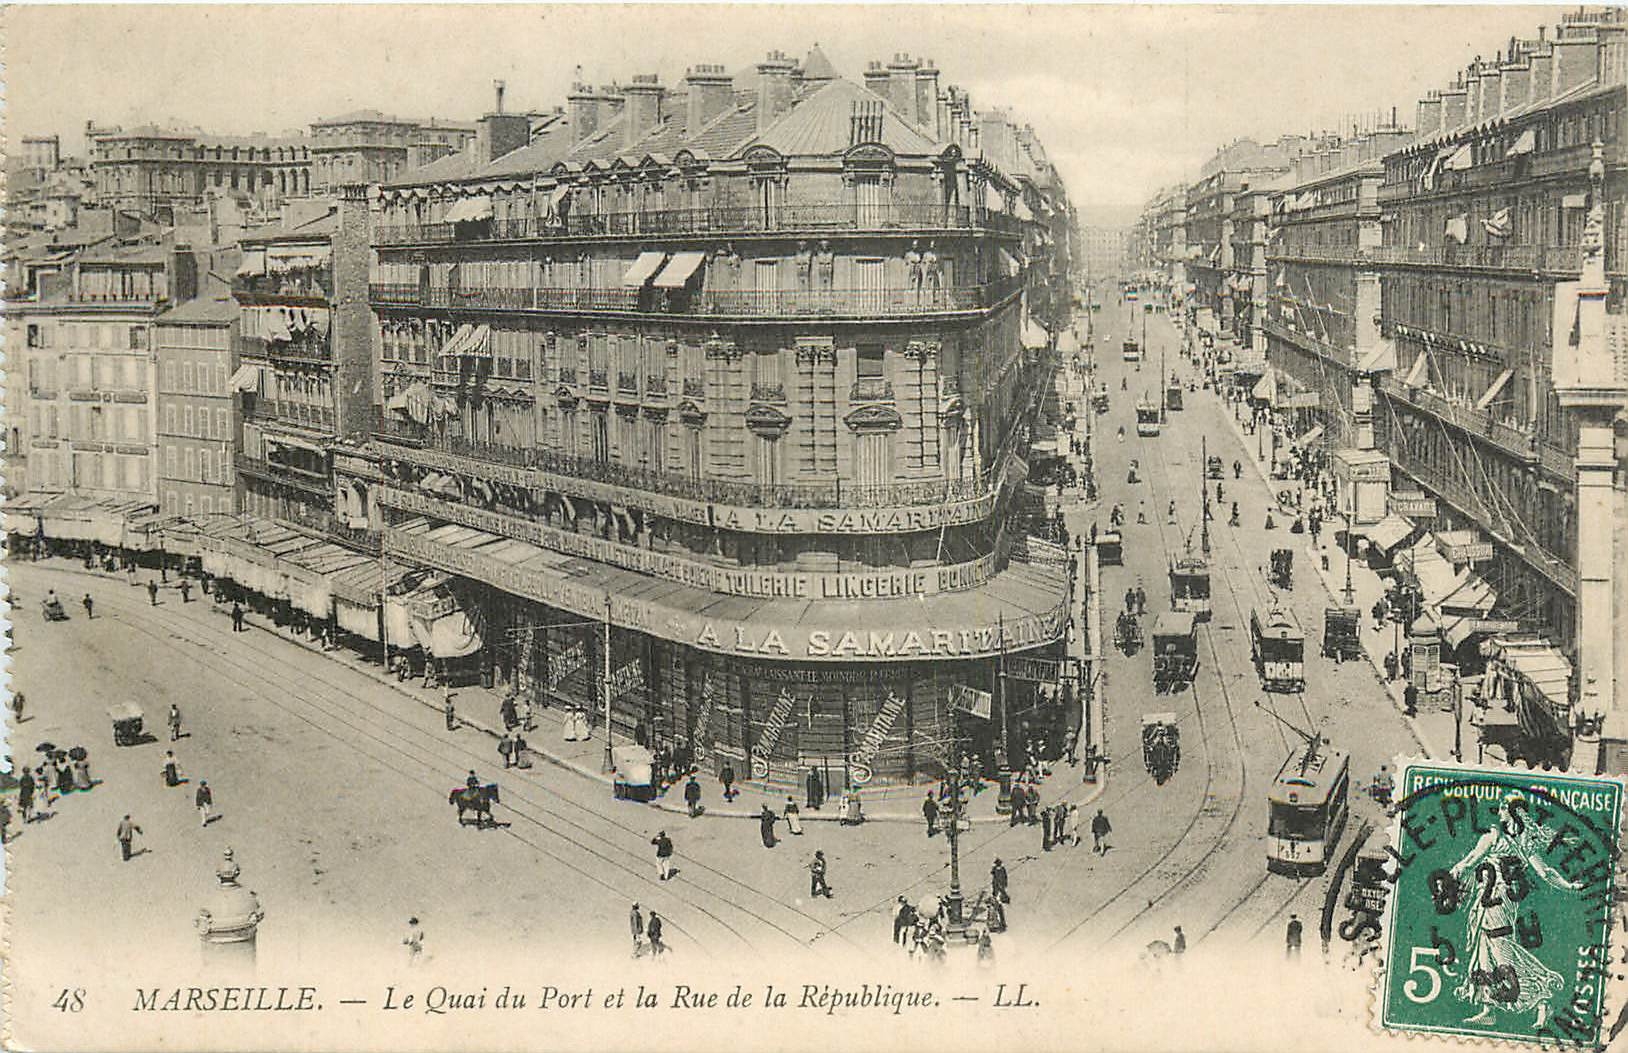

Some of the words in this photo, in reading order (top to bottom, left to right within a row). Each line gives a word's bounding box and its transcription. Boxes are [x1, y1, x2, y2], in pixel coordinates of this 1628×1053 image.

[725, 509, 742, 529] A
[755, 512, 803, 532] LA
[822, 573, 925, 598] LINGERIE
[696, 622, 722, 649] A
[734, 626, 790, 656] LA
[806, 609, 1061, 659] SAMARITAINE
